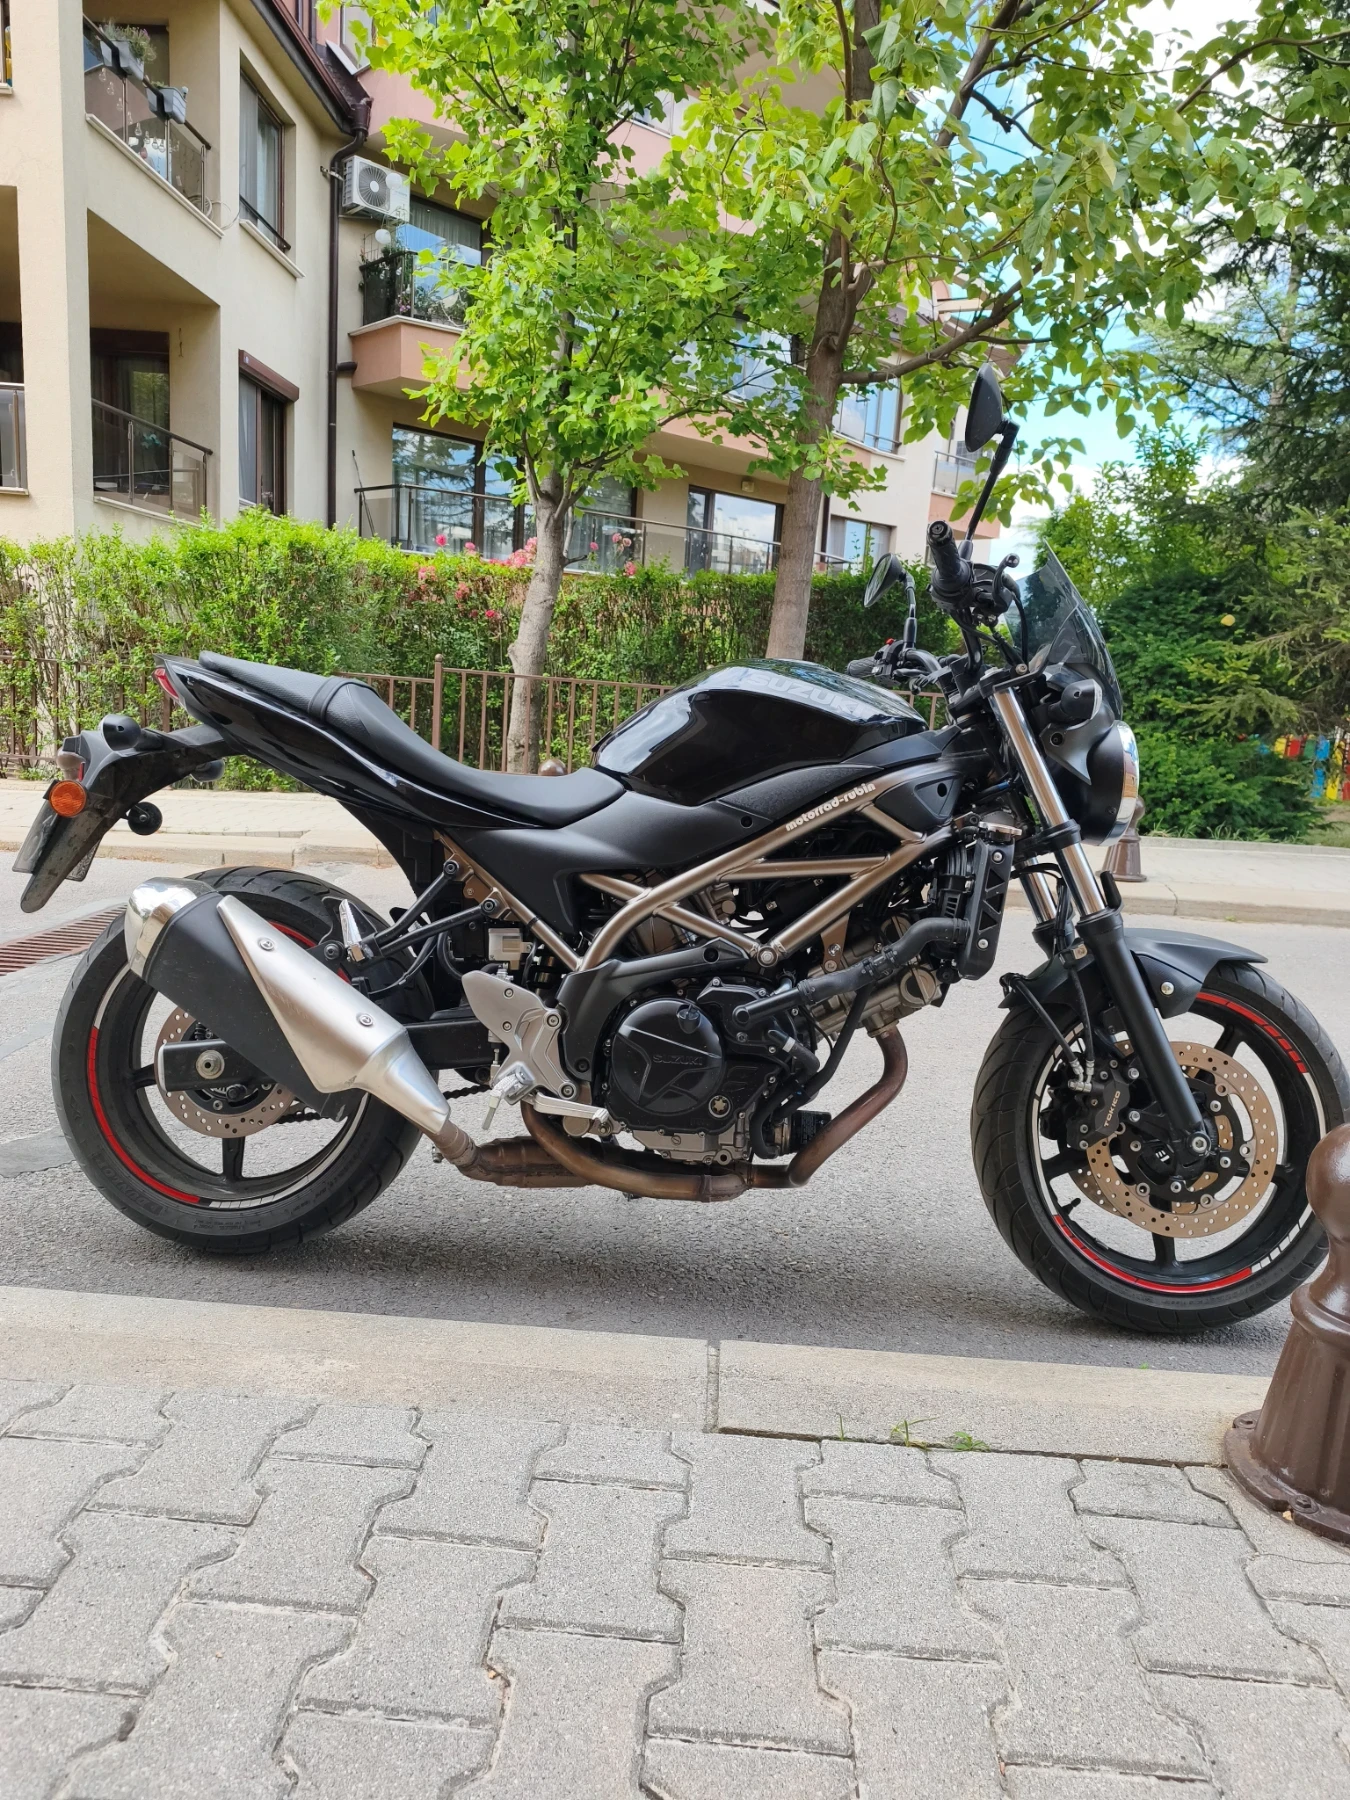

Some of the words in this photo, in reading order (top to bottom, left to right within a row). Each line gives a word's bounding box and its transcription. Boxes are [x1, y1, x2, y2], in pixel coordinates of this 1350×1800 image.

[747, 673, 865, 718] SUZUKI
[785, 783, 876, 831] motorrad-rubin
[653, 1055, 703, 1066] SUZUKI
[1104, 1090, 1121, 1127] TOKICO
[95, 1156, 150, 1207] DUNLOP
